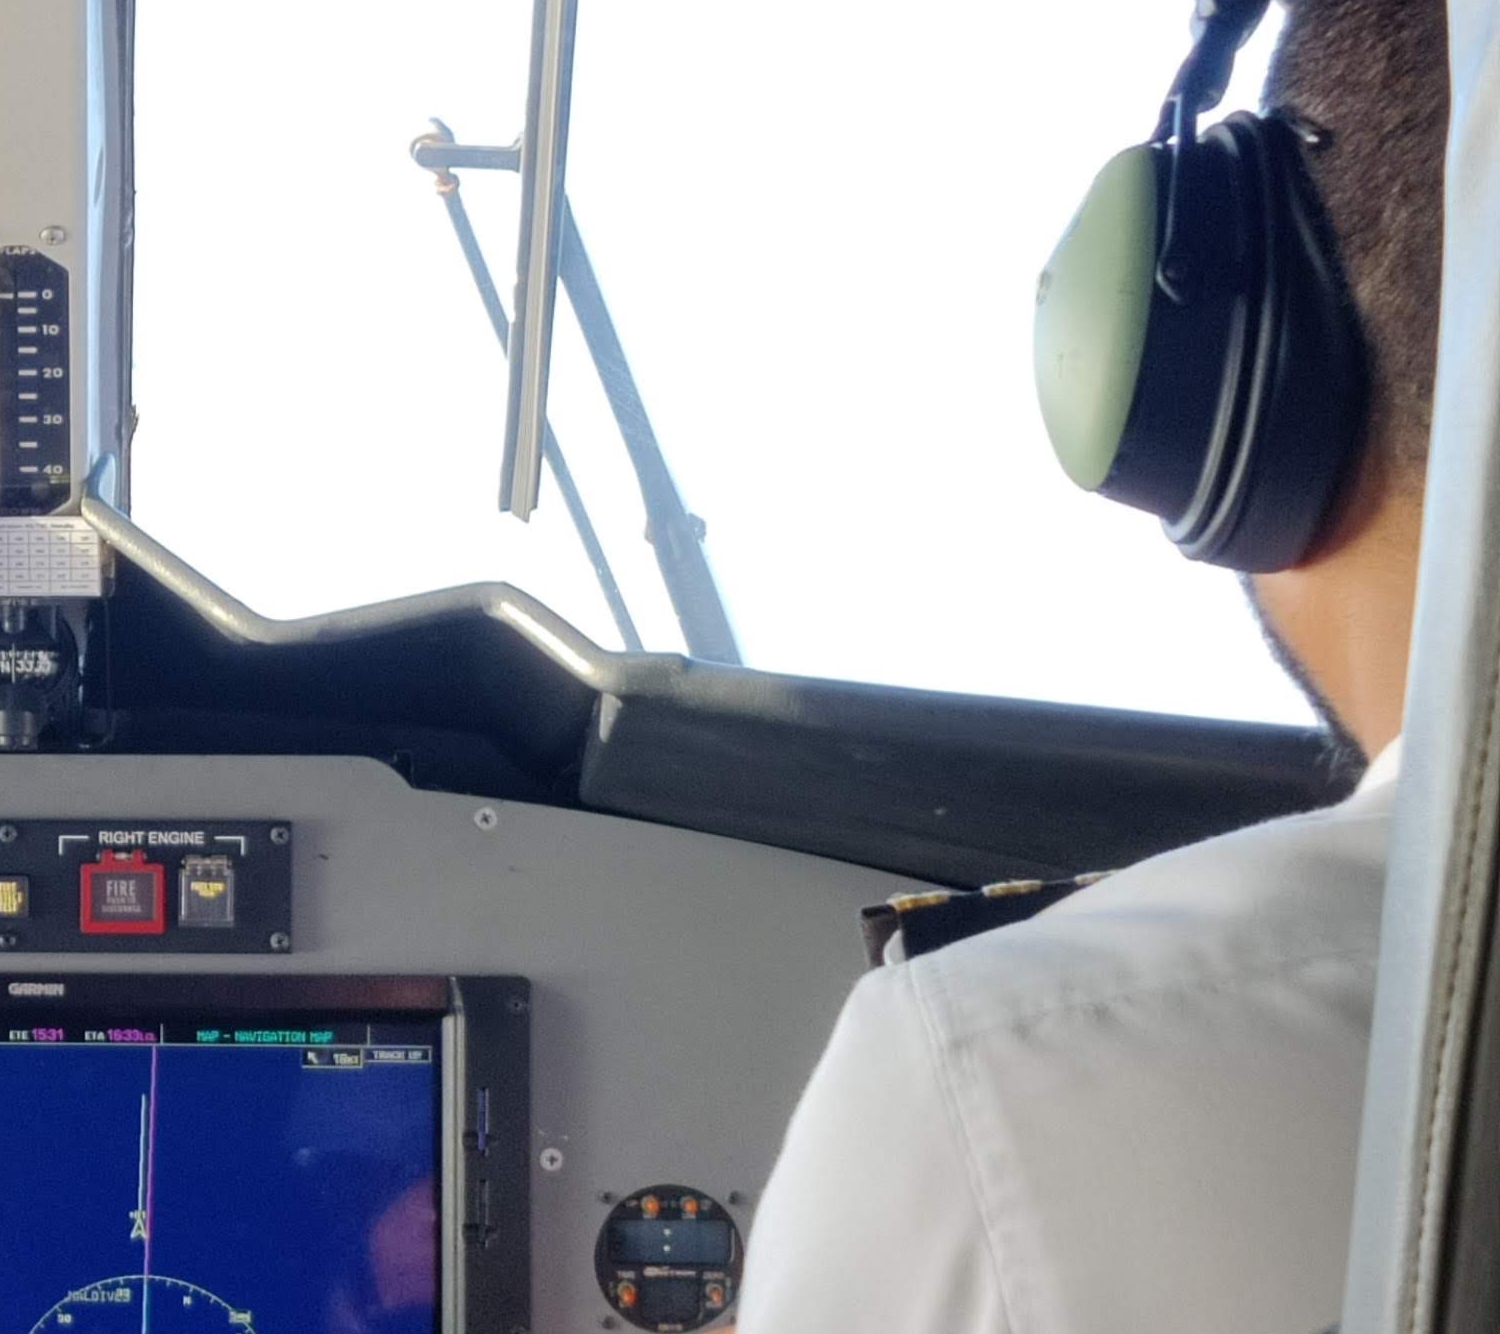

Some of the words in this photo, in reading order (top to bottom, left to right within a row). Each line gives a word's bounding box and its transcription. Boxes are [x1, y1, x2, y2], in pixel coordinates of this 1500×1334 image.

[41, 288, 53, 300] 0
[41, 324, 60, 336] 10
[42, 367, 64, 378] 20
[42, 414, 64, 425] 30
[42, 465, 64, 475] 40
[97, 831, 144, 845] RIGHT
[147, 831, 205, 845] ENGINE
[105, 879, 137, 896] FIRE
[8, 982, 65, 996] GARMIN
[9, 1030, 29, 1041] ETE
[84, 1030, 105, 1042] ETA
[196, 1030, 219, 1042] MAP
[235, 1031, 306, 1043] NAVIGATION
[309, 1032, 333, 1044] MAP
